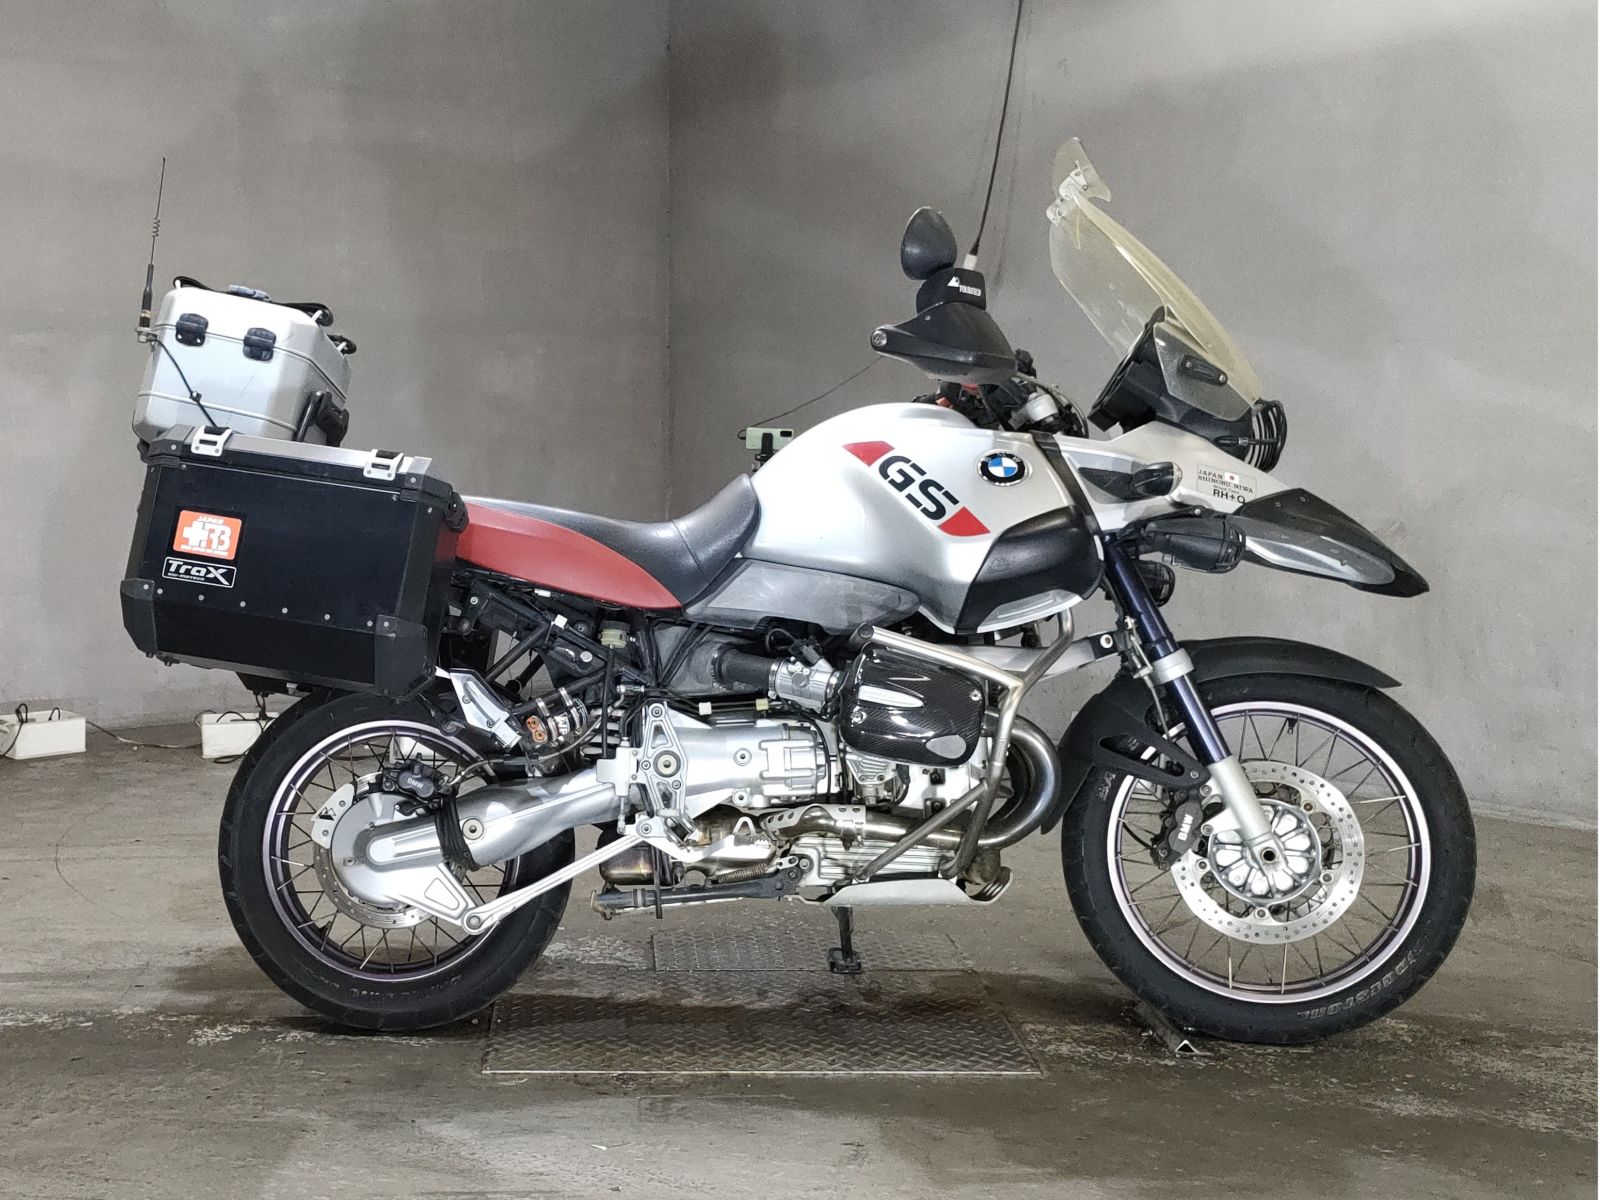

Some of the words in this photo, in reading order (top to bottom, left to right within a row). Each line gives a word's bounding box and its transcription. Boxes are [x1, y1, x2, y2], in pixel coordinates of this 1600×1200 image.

[1198, 469, 1223, 480] JAPAN
[878, 455, 960, 521] GS
[1233, 483, 1254, 494] NIWA
[406, 777, 425, 790] BMW
[1177, 813, 1194, 841] BMW
